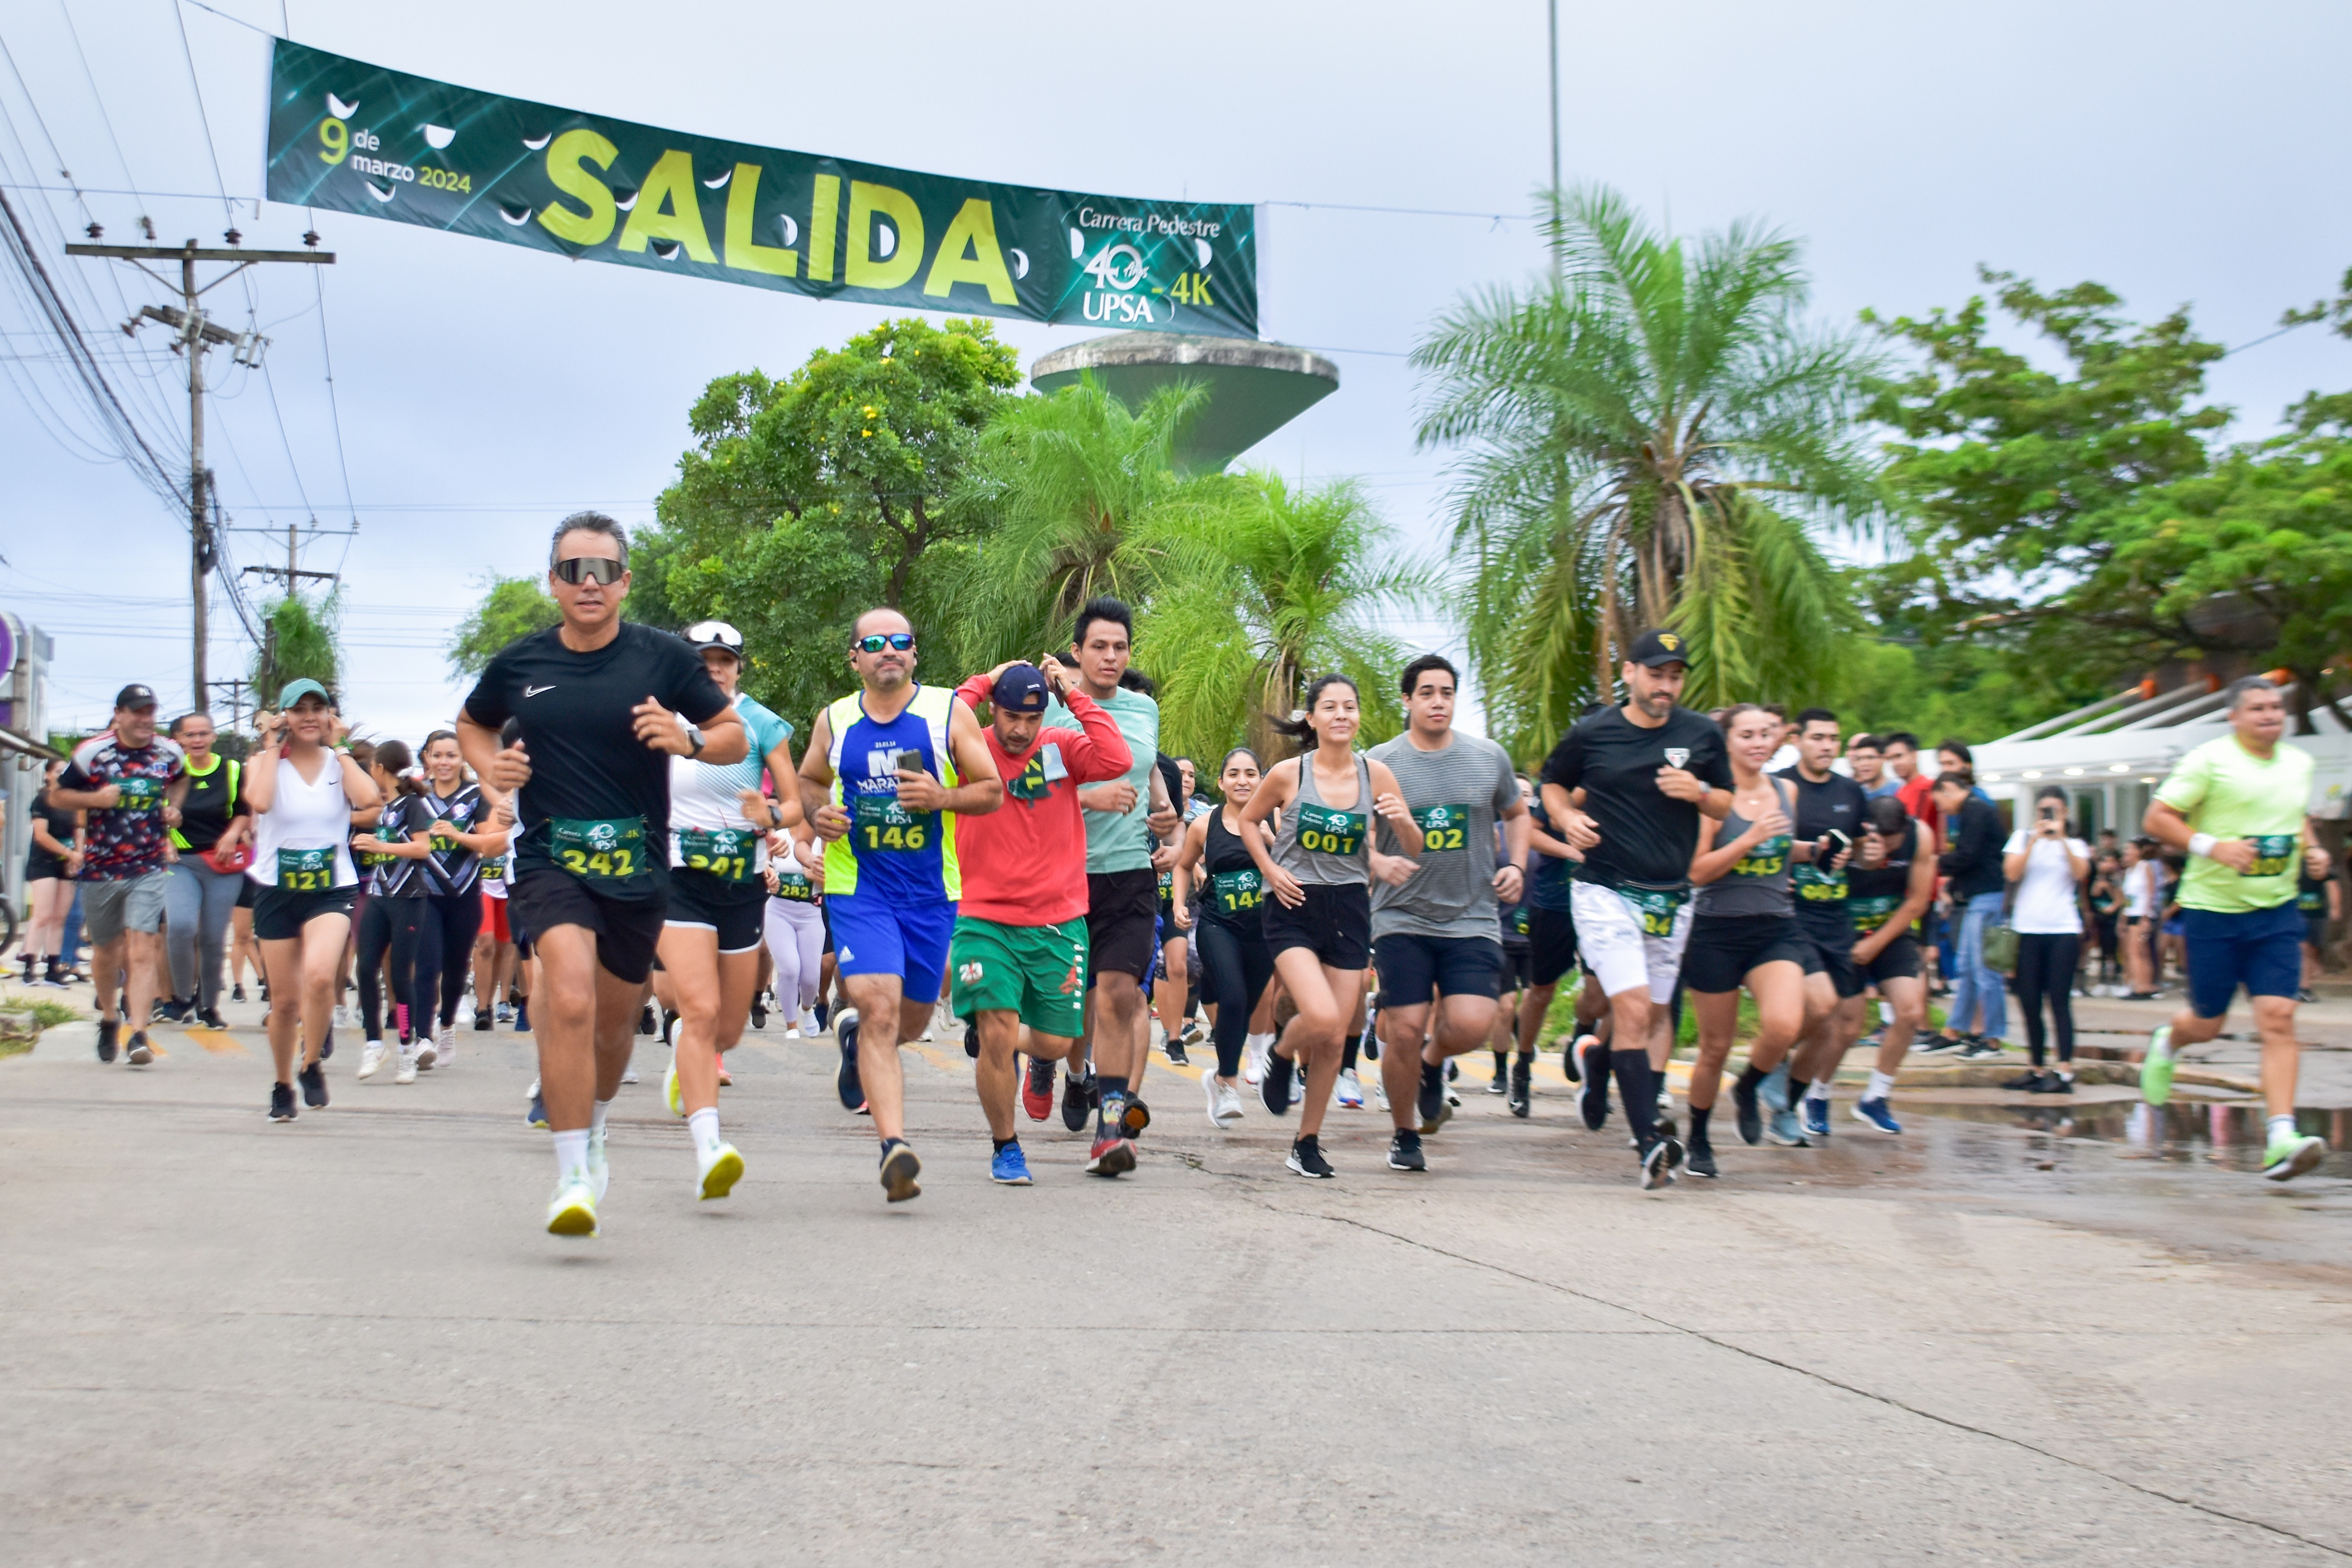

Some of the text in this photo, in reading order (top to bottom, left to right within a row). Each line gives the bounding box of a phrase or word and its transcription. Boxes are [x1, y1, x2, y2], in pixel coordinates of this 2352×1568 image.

[318, 117, 381, 165] 9 de
[353, 154, 471, 194] marzo 2024
[537, 129, 1019, 306] SALIDA
[1079, 207, 1220, 237] Carrera Pedestre
[1084, 243, 1143, 291] 40
[1170, 272, 1213, 305] 4K
[1083, 292, 1155, 323] UPSA
[885, 814, 912, 824] UPSA
[587, 823, 617, 840] 40
[865, 825, 925, 849] 146
[1302, 831, 1354, 853] 001
[1426, 828, 1463, 849] 02
[589, 839, 617, 850] UPSA
[482, 867, 503, 878] 27
[563, 849, 634, 876] 242
[285, 869, 330, 890] 121
[781, 884, 810, 898] 282
[1159, 886, 1174, 899] 81
